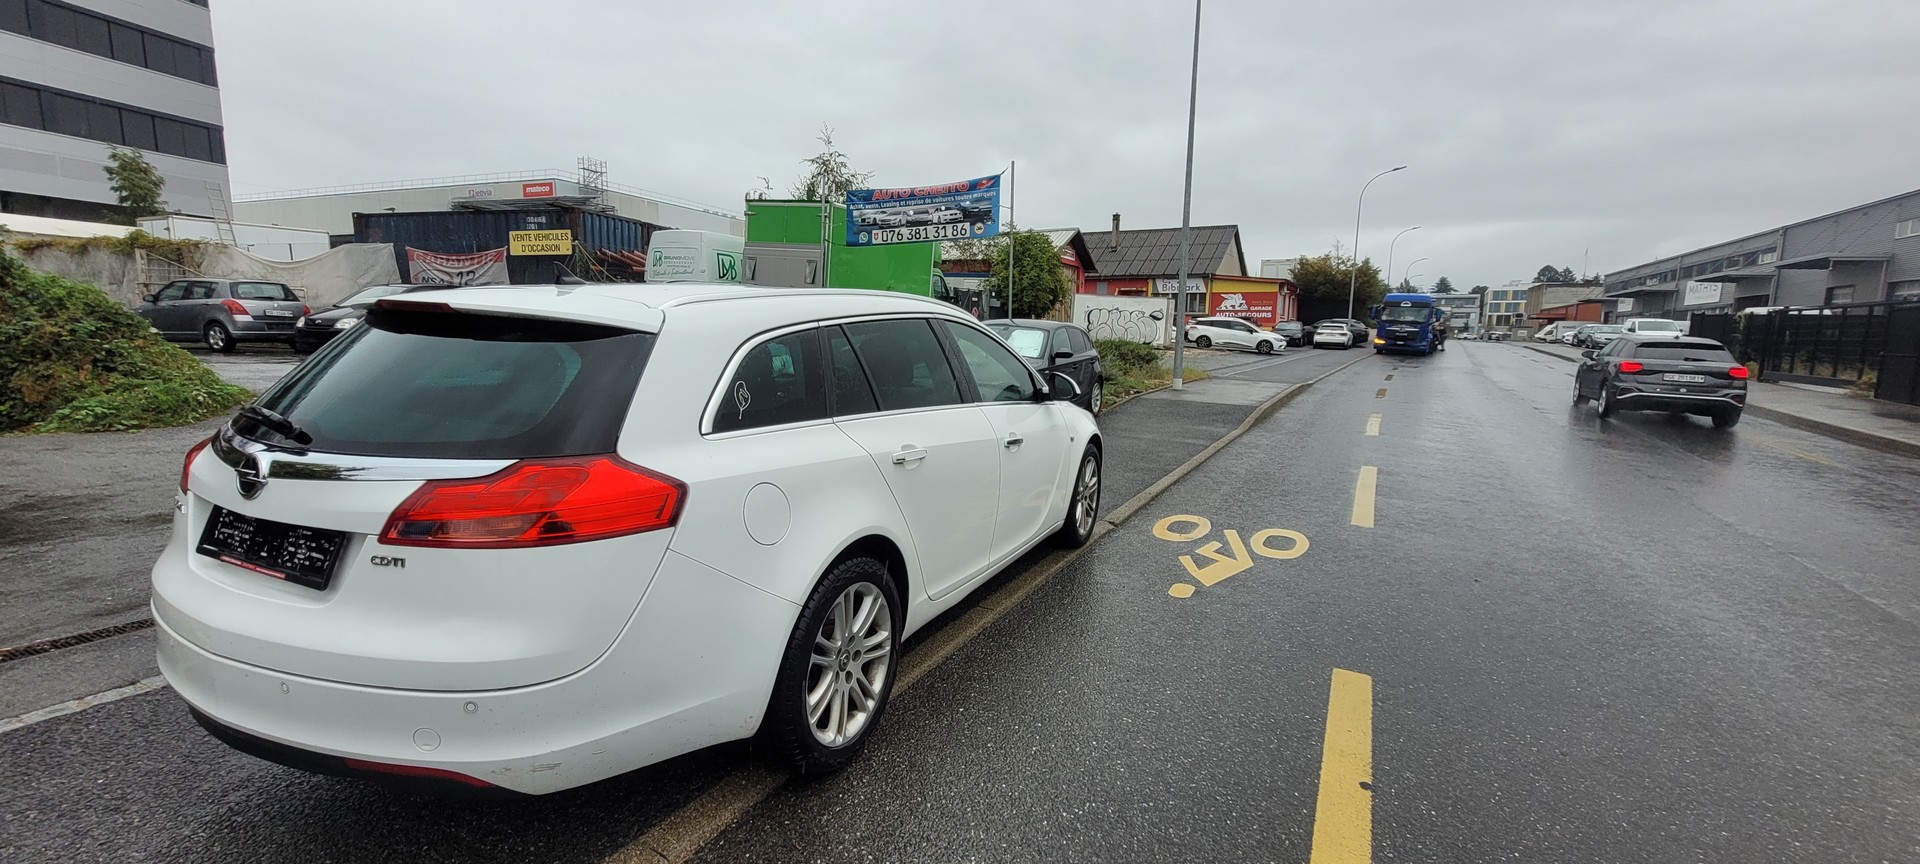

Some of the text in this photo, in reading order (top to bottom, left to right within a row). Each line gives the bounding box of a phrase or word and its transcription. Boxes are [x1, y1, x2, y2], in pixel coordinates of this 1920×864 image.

[526, 185, 550, 193] mateco
[871, 188, 911, 201] AUTO
[906, 199, 924, 207] reprise
[973, 191, 997, 199] marques
[512, 233, 569, 242] VENTE VEHICULES
[881, 224, 967, 243] 076 381 31 86
[521, 244, 561, 253] D'OCCASION
